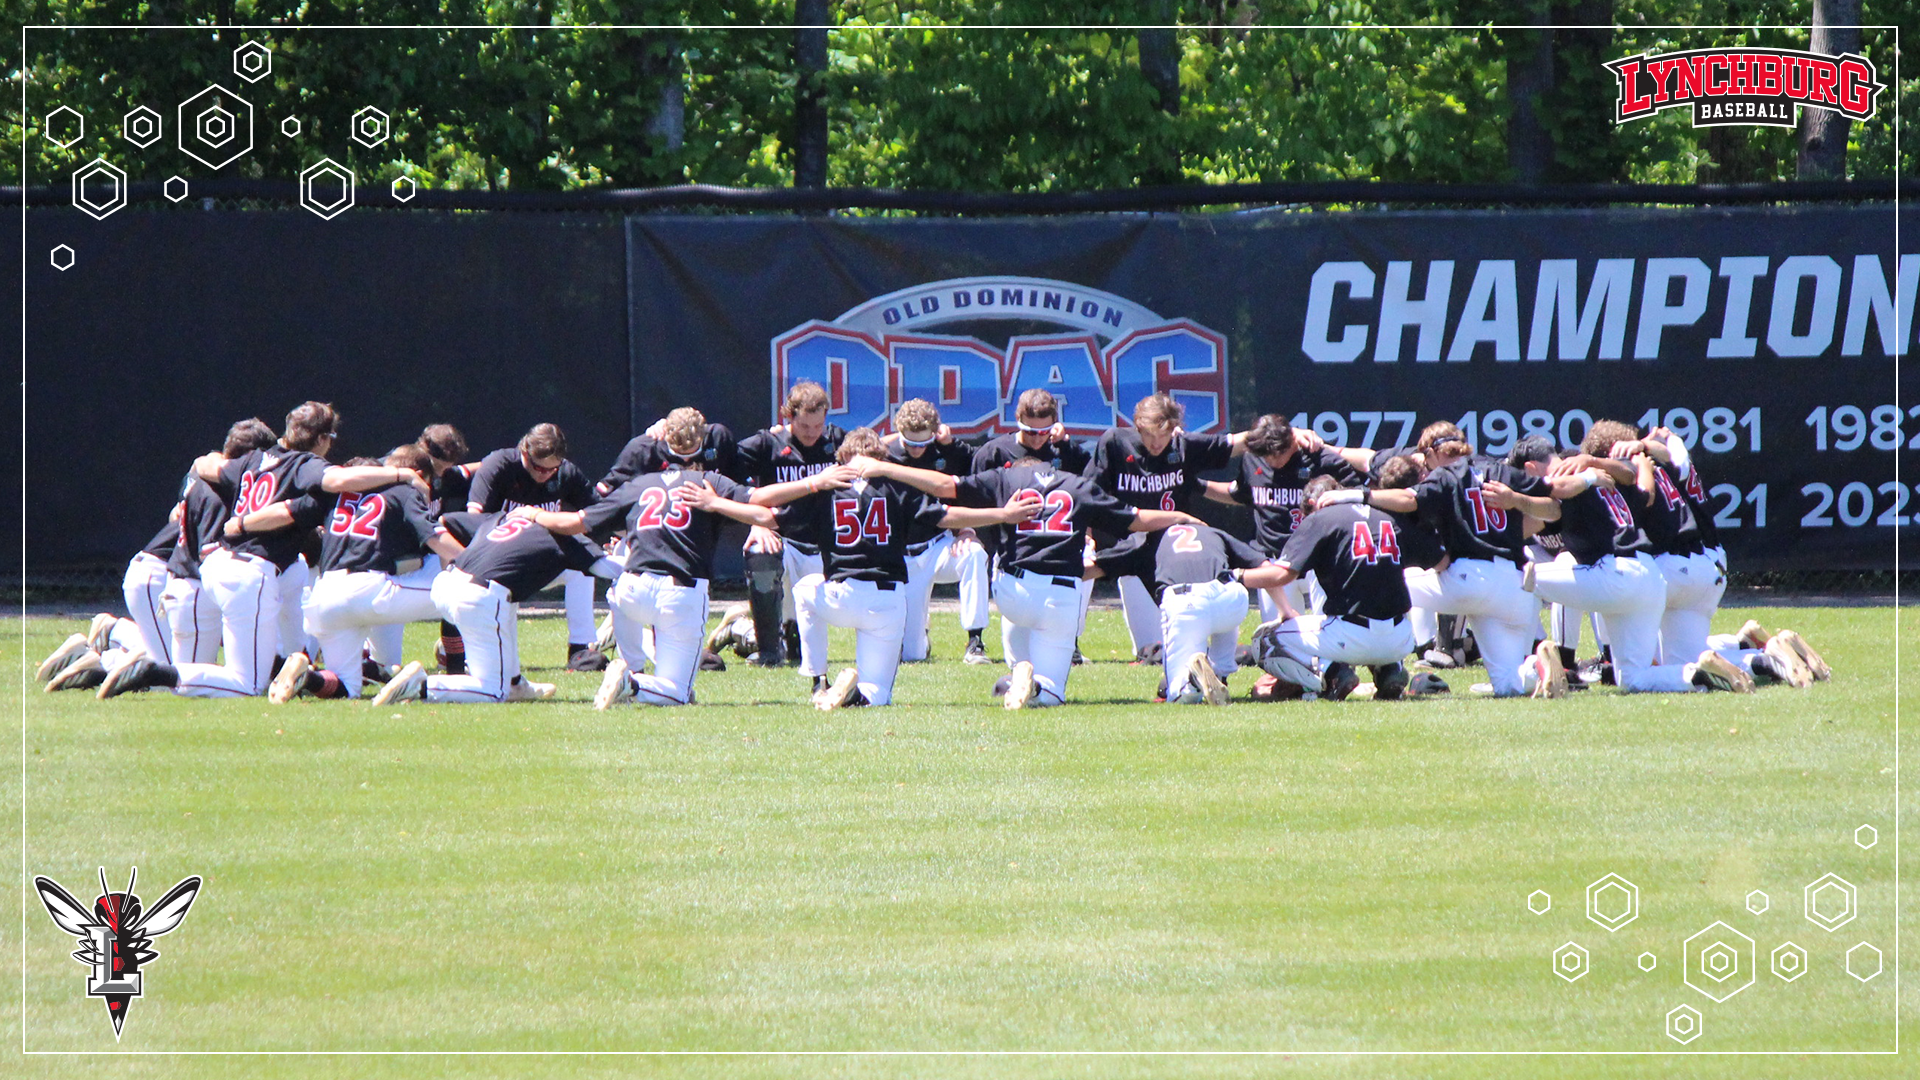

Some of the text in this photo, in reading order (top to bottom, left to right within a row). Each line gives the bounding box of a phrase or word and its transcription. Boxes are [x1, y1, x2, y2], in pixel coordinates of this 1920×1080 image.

[882, 288, 1124, 328] OLD DOMINION
[771, 318, 1228, 437] ODAC
[1454, 409, 1595, 456] 1980
[1637, 406, 1761, 452] 1981
[234, 470, 276, 518] 30
[1117, 468, 1184, 494] LYNCHBURG
[1160, 491, 1176, 512] 6
[330, 491, 386, 541] 52
[832, 497, 891, 547] 54
[1015, 488, 1074, 534] 22
[1465, 487, 1507, 534] 16
[1709, 481, 1920, 528] 21 202
[486, 517, 533, 542] 5
[1167, 523, 1203, 553] 2
[1351, 520, 1401, 565] 44
